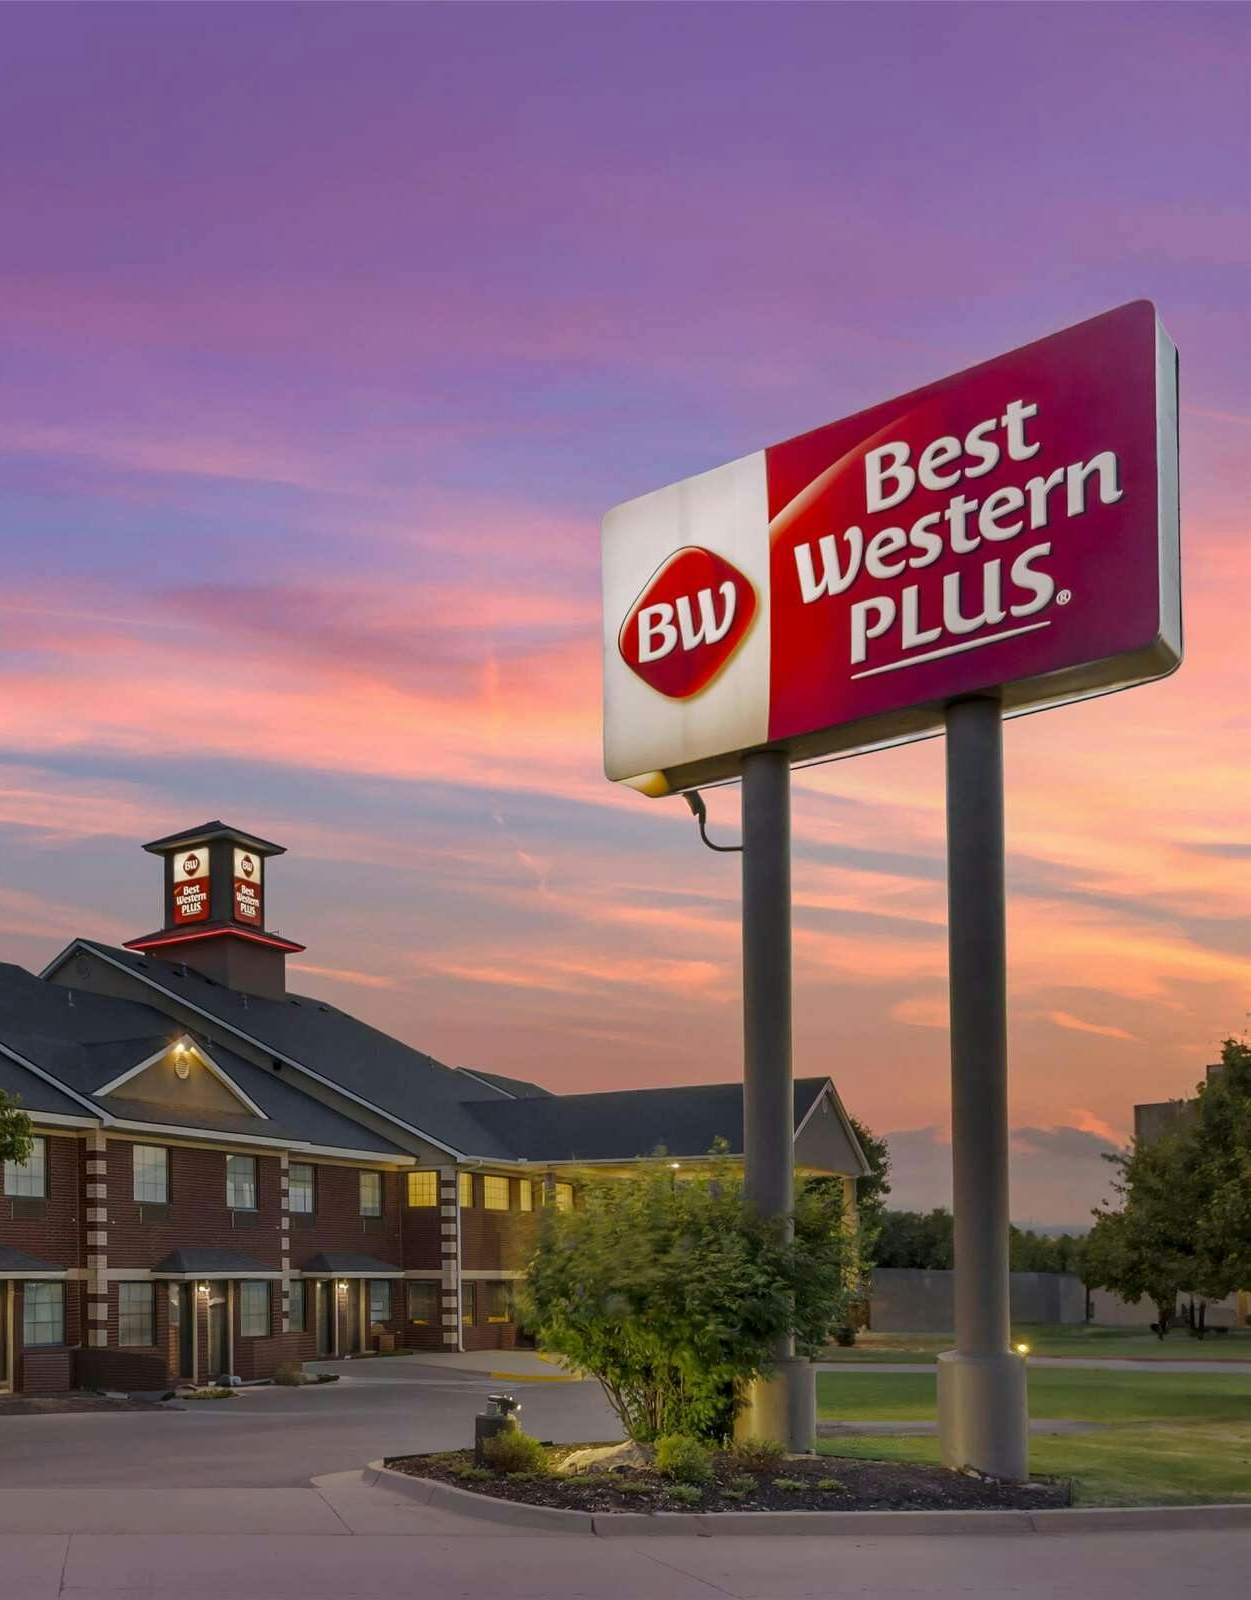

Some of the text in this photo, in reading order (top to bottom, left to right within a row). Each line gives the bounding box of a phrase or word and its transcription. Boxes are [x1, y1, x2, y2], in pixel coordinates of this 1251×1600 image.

[866, 400, 1040, 513] Best
[794, 451, 1124, 603] Western
[638, 581, 736, 663] BW
[184, 859, 198, 871] BW
[242, 860, 253, 872] BW
[183, 885, 200, 896] Best
[241, 884, 254, 898] Best
[176, 893, 207, 906] Western
[181, 902, 203, 914] PLUS
